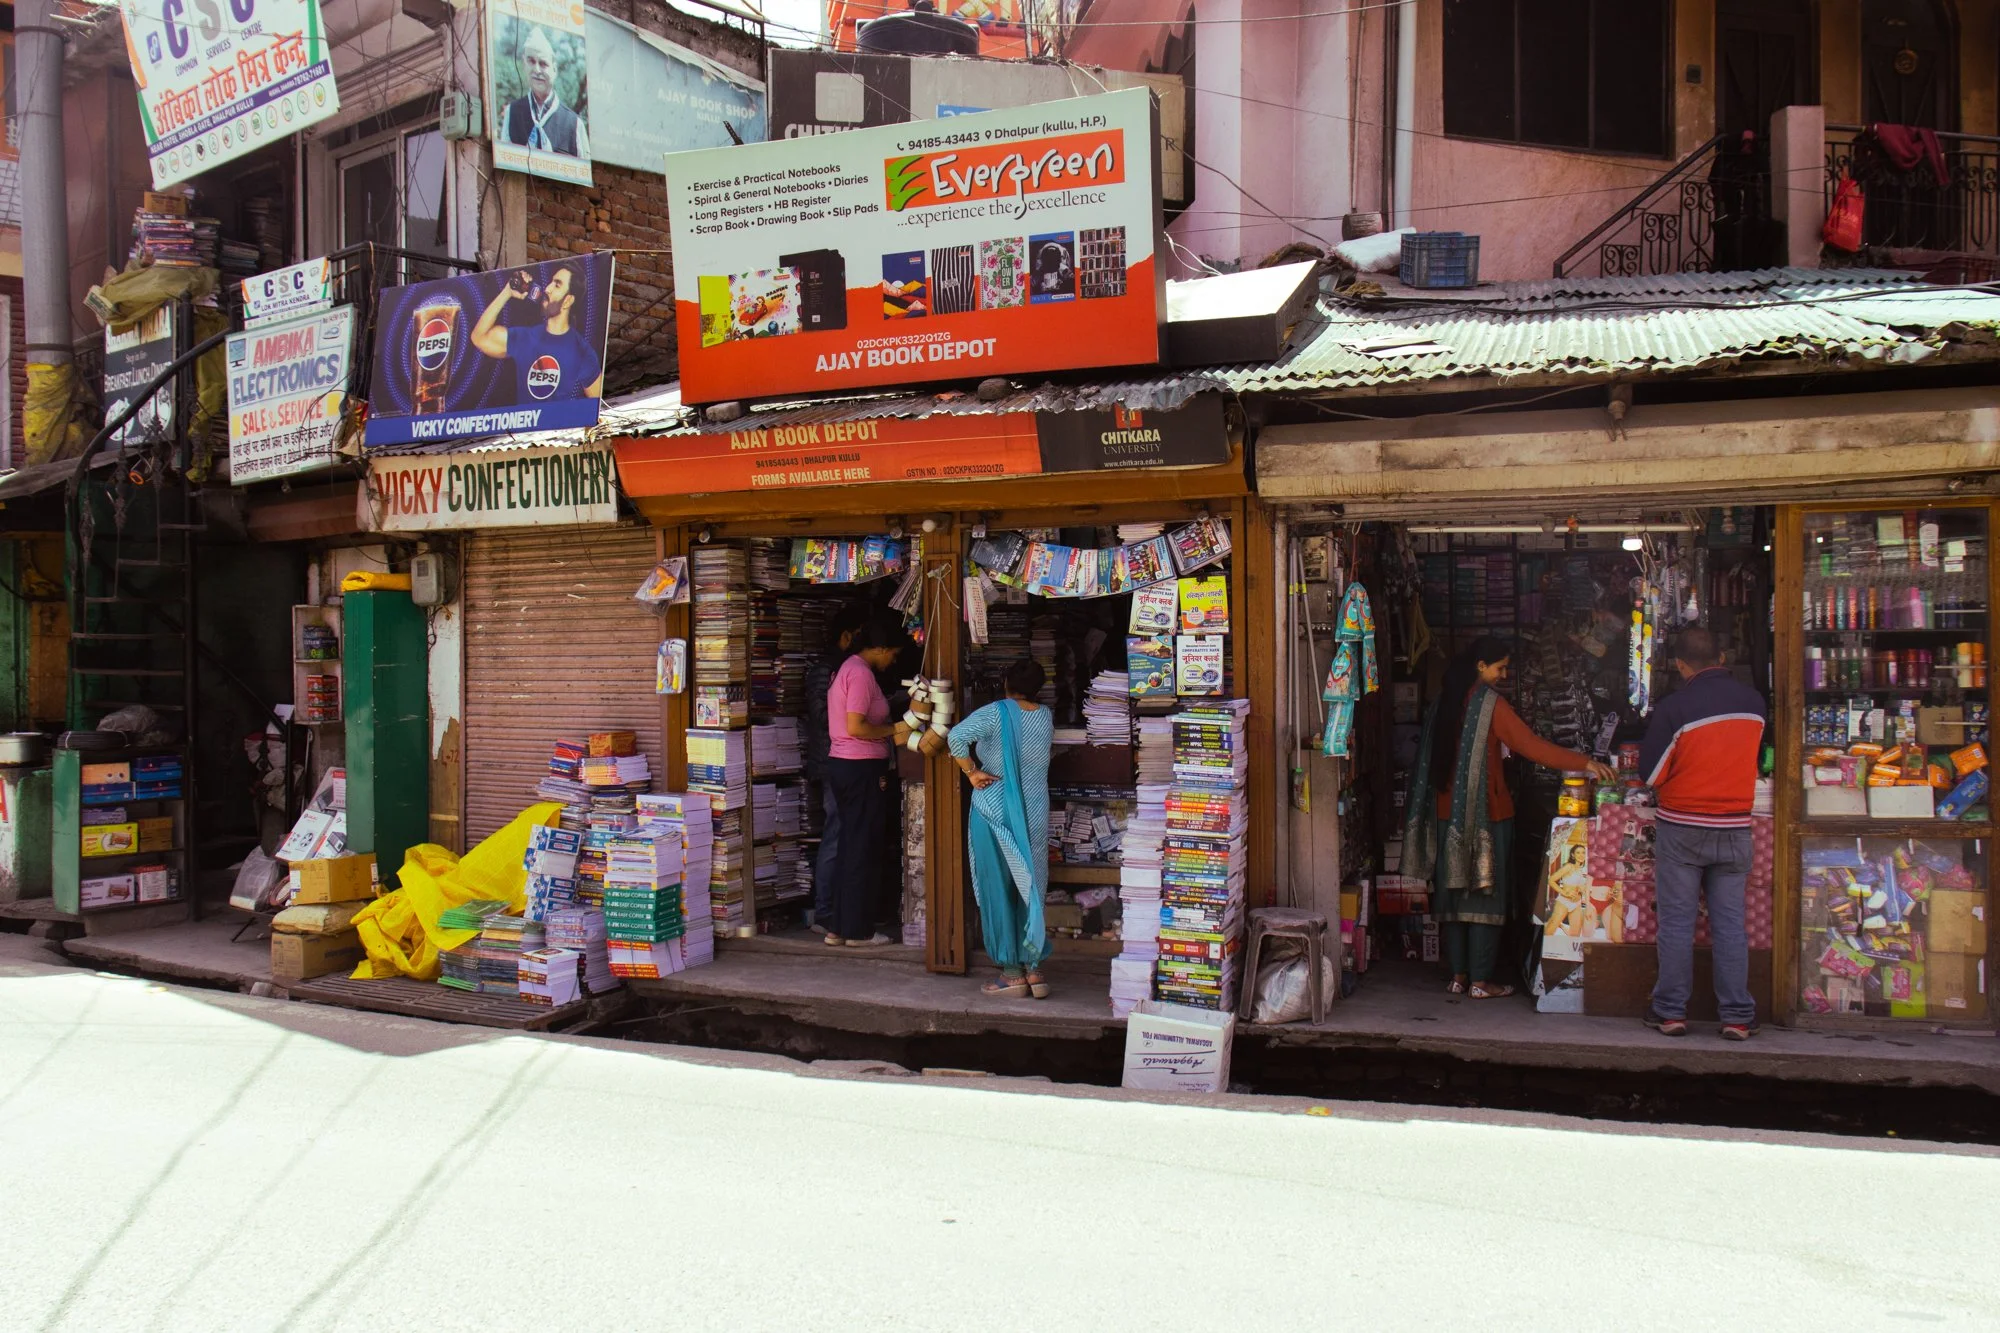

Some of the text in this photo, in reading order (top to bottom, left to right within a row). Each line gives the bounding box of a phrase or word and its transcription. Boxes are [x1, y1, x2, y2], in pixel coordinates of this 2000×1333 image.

[174, 21, 263, 77] COMMON SERVICES CENTRE
[152, 29, 309, 136] अंबिका लोक मित्र केन्द्र
[657, 87, 756, 121] AJAY BOOK SHOP
[162, 134, 178, 150] HOTEL
[211, 105, 236, 127] DHALPUR
[236, 94, 254, 114] KULLU
[908, 115, 1107, 151] 94185-43443 Dhalpur (kullu, H.P.)
[693, 163, 841, 192] Exercise & Practical Notebooks
[693, 174, 869, 207] Spiral & General Notebooks Diaries
[930, 143, 1115, 220] Evergreen
[695, 194, 831, 223] Long Registers HB Register
[989, 199, 1013, 215] the
[1028, 189, 1106, 211] excellence
[696, 203, 879, 236] Scrap Book Drawing Book Slip Pads
[260, 303, 272, 312] LOK
[272, 299, 288, 310] MITRA
[289, 293, 310, 304] KENDRA
[252, 325, 315, 369] AMBIKA
[418, 337, 450, 352] PEPSI
[815, 337, 997, 373] AJAY BOOK DEPOT
[231, 353, 339, 406] ELECTRONICS
[529, 371, 558, 384] PEPSI
[242, 407, 267, 437] SALE
[277, 396, 323, 427] SERVICE
[411, 409, 542, 438] VICKY CONFECTIONERY
[731, 420, 878, 450] AJAY BOOK DEPOT
[1101, 428, 1162, 445] CHITKARA
[1103, 443, 1162, 455] UNIVERSITY
[838, 452, 861, 464] KULLU
[906, 467, 926, 478] GSTIN
[1103, 458, 1164, 468] www.chitkara.edu.in
[375, 450, 612, 516] VICKY CONFECTIONERY
[752, 467, 871, 487] FORMS AVAILABLE HERE
[1169, 840, 1181, 848] NEET
[1142, 1031, 1153, 1040] FOIL
[1185, 1037, 1213, 1047] AGGARWAL
[1142, 1056, 1205, 1068] Aggarwals
